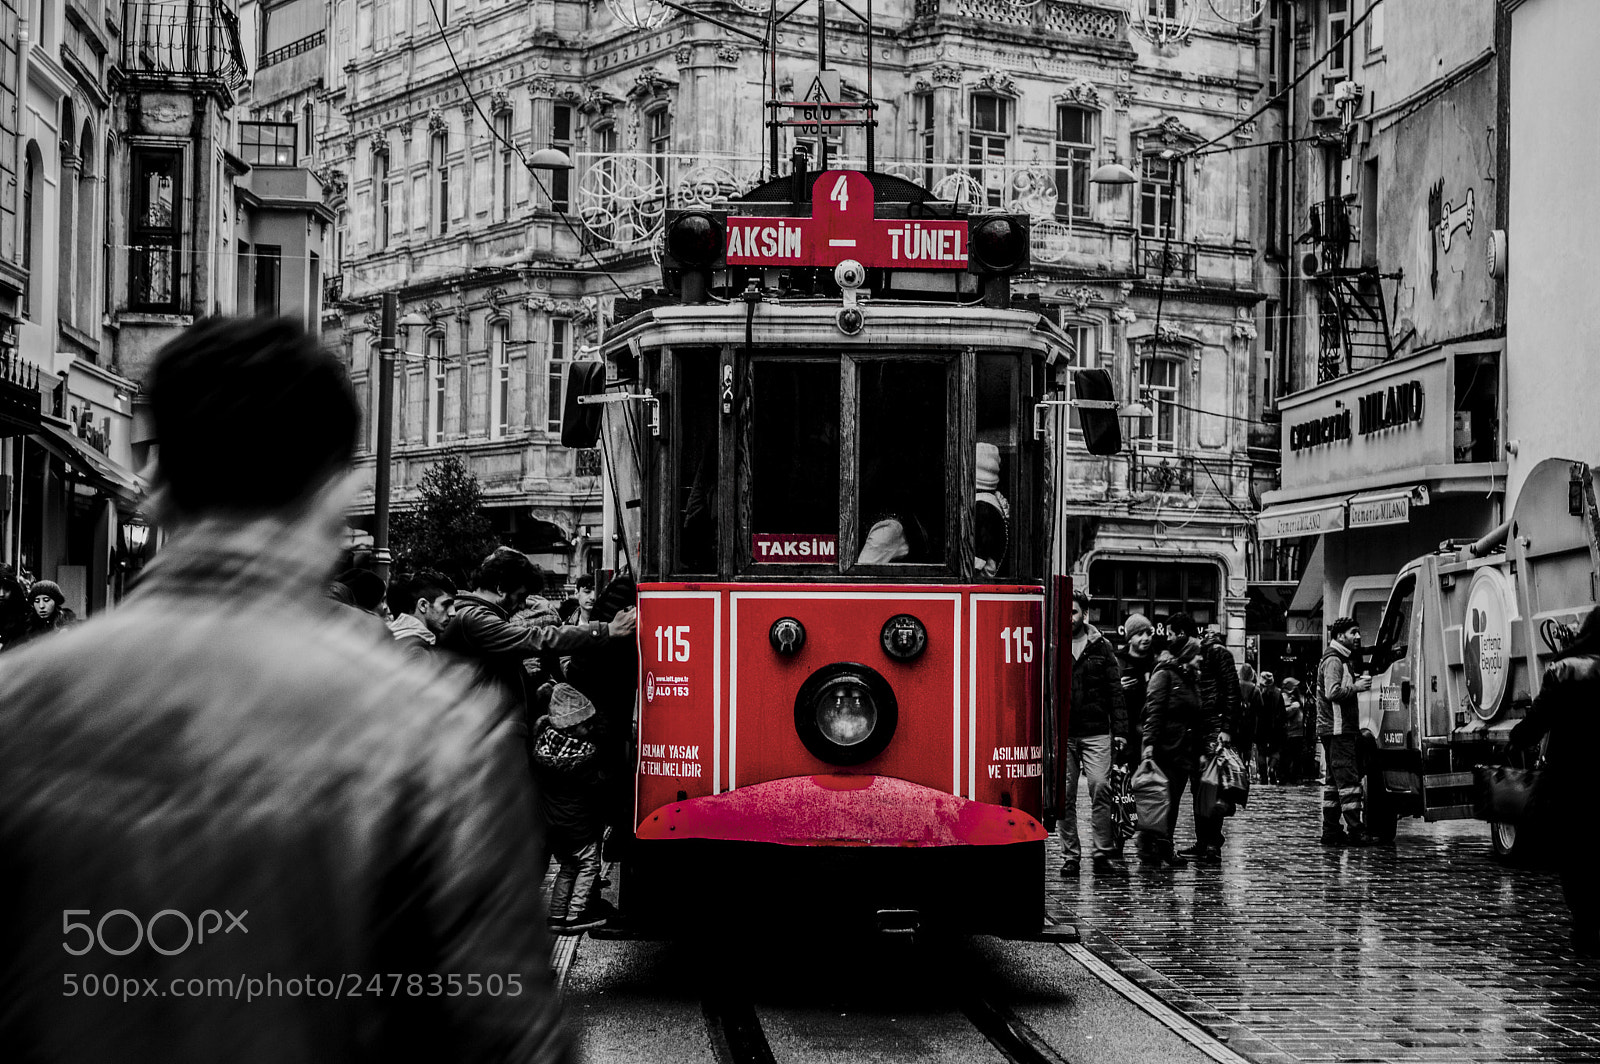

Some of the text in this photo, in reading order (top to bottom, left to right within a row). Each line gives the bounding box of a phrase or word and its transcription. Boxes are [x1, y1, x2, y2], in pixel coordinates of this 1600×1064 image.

[830, 175, 849, 211] 4
[727, 221, 801, 258] AKSİM
[887, 223, 968, 260] TÜNEL
[1358, 380, 1425, 435] MILANO
[758, 538, 835, 556] TAKSİM
[655, 625, 690, 662] 115
[1000, 626, 1033, 664] 115
[655, 686, 689, 696] ALO 153
[668, 744, 699, 760] YASAK
[987, 764, 1001, 779] VE
